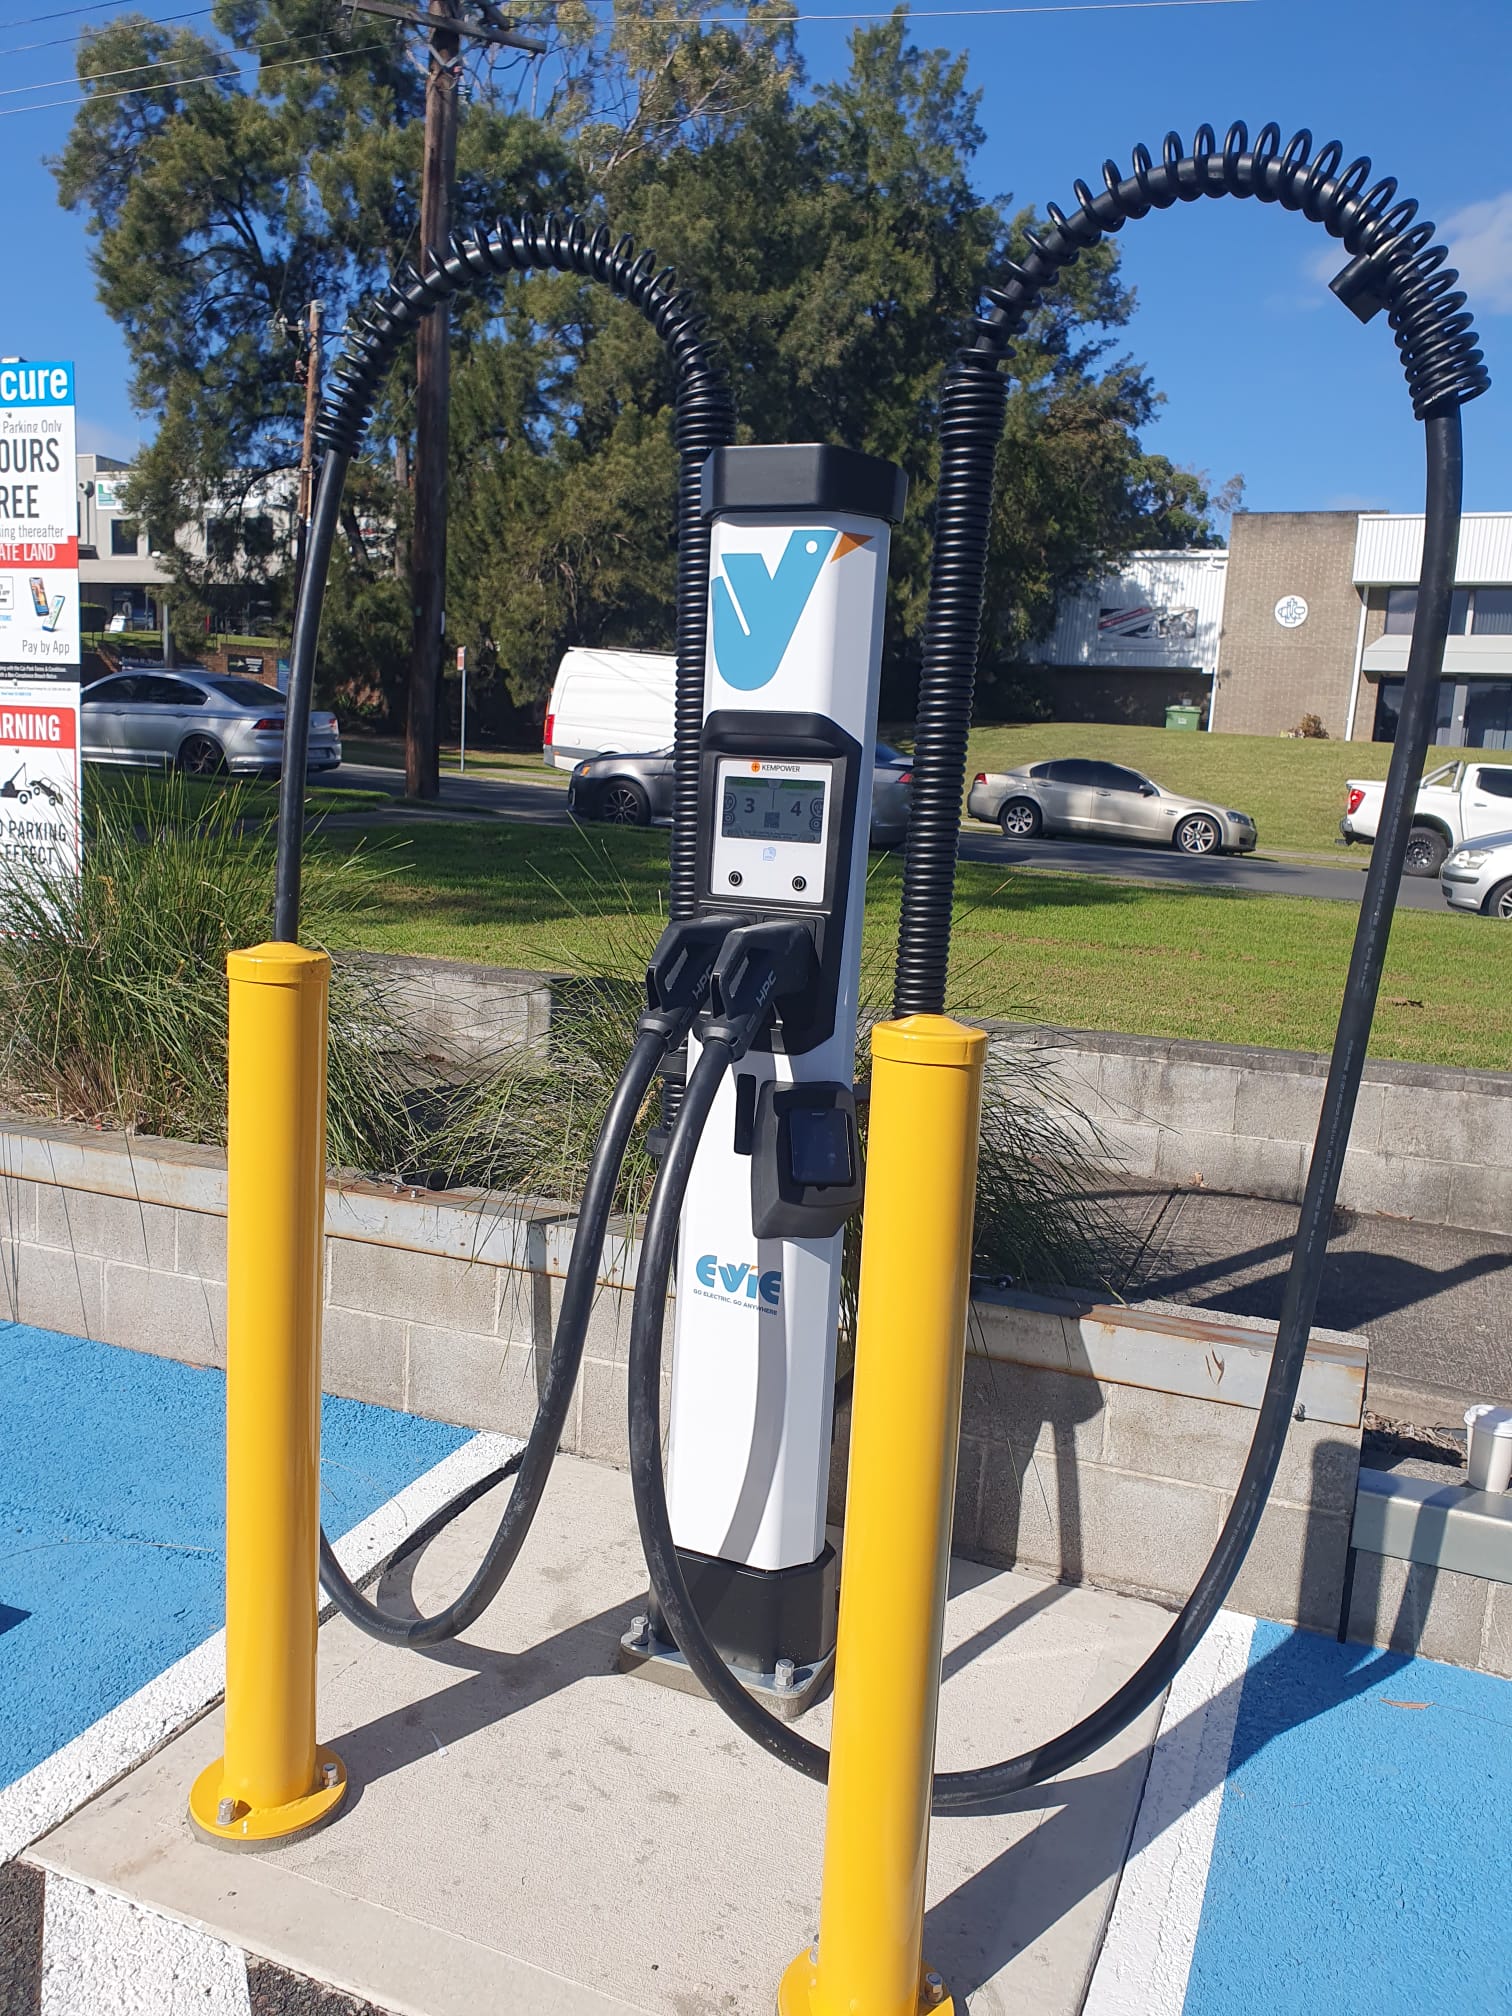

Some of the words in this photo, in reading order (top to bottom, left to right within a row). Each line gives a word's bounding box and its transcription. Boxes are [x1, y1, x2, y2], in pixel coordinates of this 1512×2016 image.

[2, 419, 39, 434] Parking
[41, 419, 63, 433] Only
[18, 524, 64, 538] thereafter
[23, 543, 56, 562] LAND
[22, 639, 38, 656] Pay
[40, 640, 51, 656] by
[52, 640, 70, 656] App
[0, 712, 61, 742] RNING
[761, 764, 800, 773] KEMPOWER
[743, 798, 755, 814] 3
[790, 801, 802, 817] 4
[8, 819, 67, 842] PARKING
[5, 844, 55, 865] EFFECT
[755, 968, 777, 1008] HPC
[742, 1302, 778, 1316] ANYWHERE
